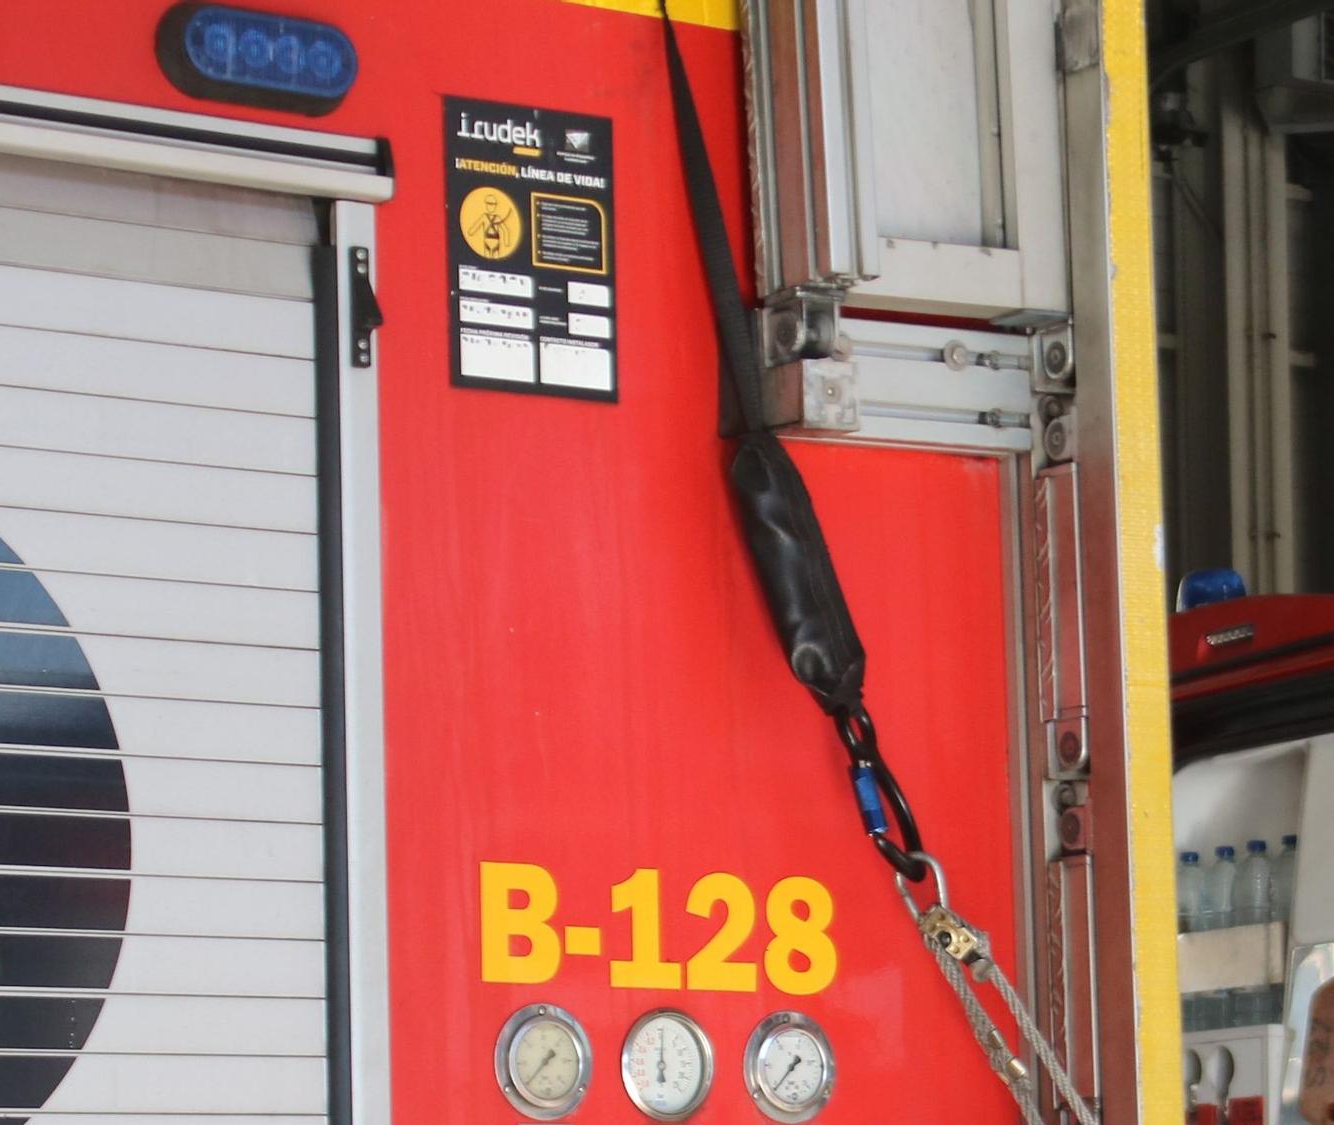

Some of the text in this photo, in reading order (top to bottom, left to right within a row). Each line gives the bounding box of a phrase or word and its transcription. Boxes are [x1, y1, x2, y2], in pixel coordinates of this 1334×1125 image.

[456, 112, 541, 148] irudek
[521, 165, 555, 183] LÍNEA
[557, 171, 573, 184] DE
[574, 174, 606, 189] VIDA!
[479, 860, 838, 996] B-128
